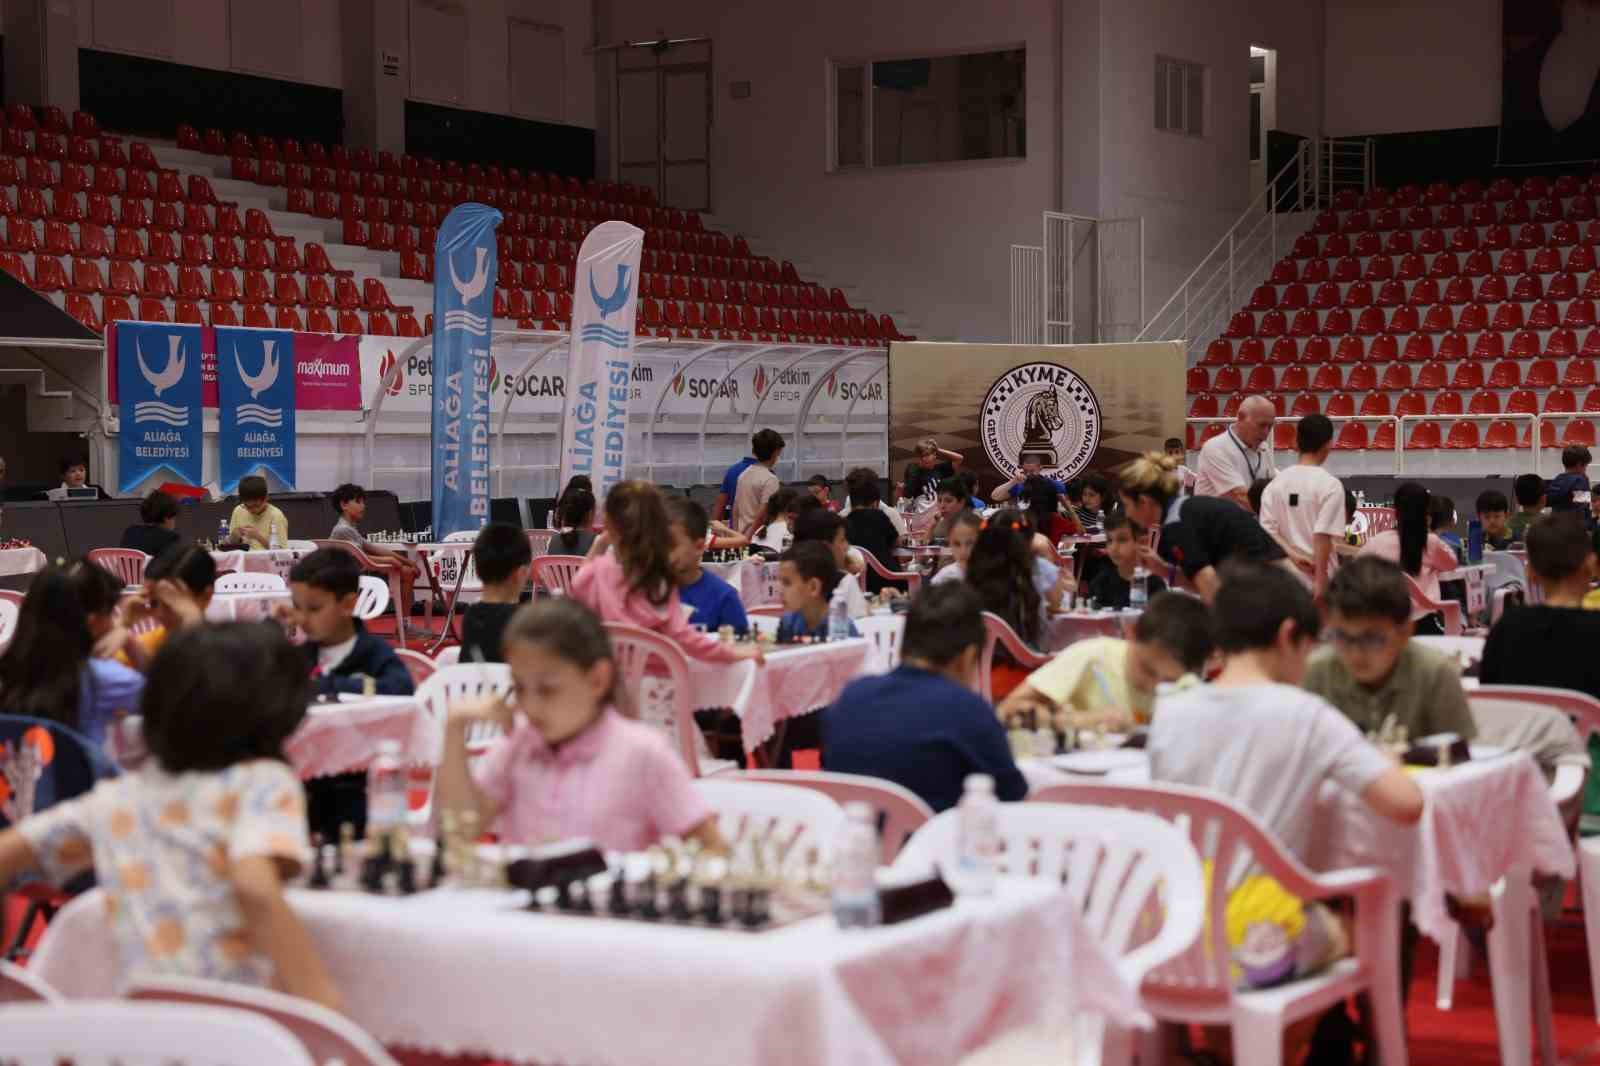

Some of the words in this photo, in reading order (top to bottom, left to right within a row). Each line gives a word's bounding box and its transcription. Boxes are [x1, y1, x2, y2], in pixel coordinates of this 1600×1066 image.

[407, 355, 432, 376] Pet
[504, 374, 565, 397] SOCAR
[689, 378, 739, 398] SOCAR
[1011, 366, 1068, 388] KYME
[841, 382, 882, 400] SOCAR
[144, 428, 181, 442] ALİAĞA
[244, 430, 277, 443] ALİAĞA
[440, 371, 464, 491] ALİAĞA
[467, 349, 489, 516] BELEDİYESİ
[569, 381, 597, 474] LİAĞA
[602, 360, 629, 495] LEDİYESİ
[136, 444, 190, 458] BELEDİYESİ
[237, 444, 284, 458] BELEDİYESİ
[986, 419, 1018, 476] GELENEKSEL
[1063, 420, 1093, 474] TURNUVASI
